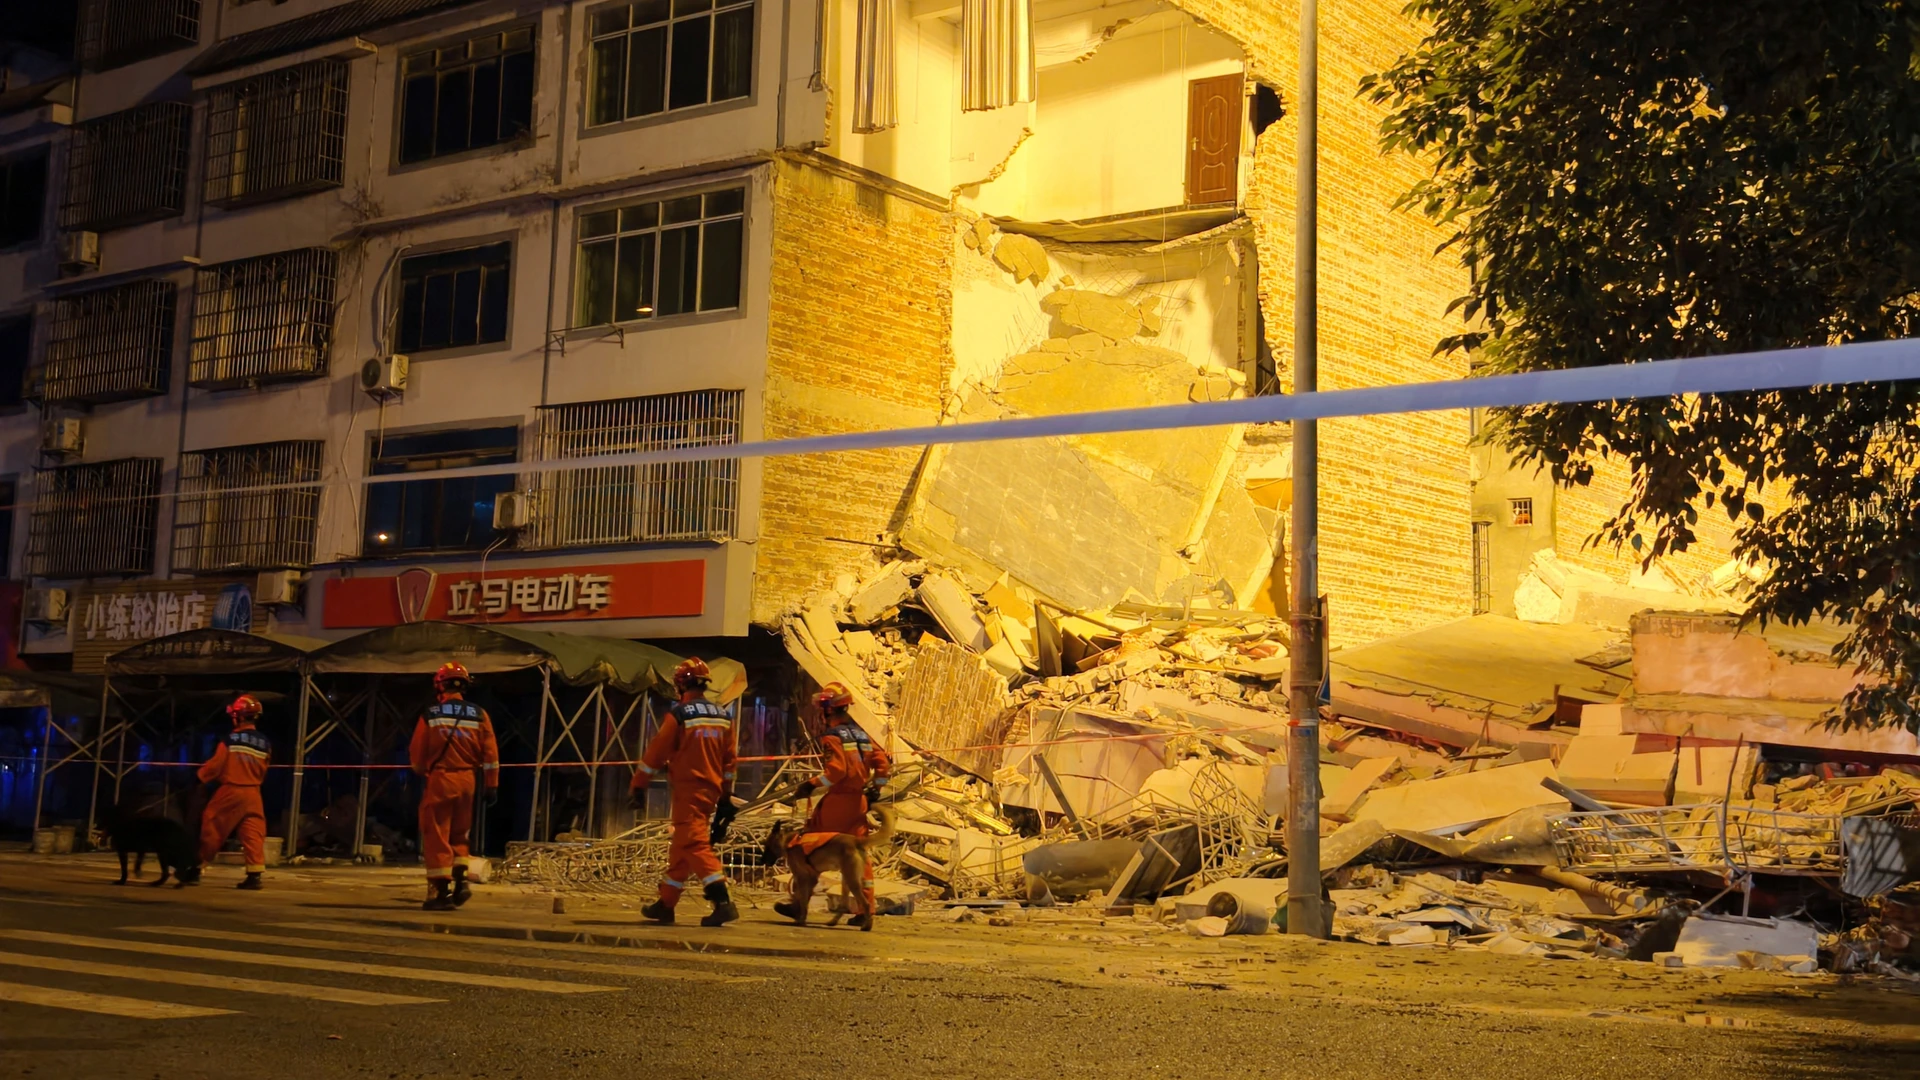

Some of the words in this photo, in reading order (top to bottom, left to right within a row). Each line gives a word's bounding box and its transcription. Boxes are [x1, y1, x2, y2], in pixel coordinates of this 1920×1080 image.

[84, 591, 206, 640] 小练轮胎店
[448, 575, 611, 616] 立马电动车
